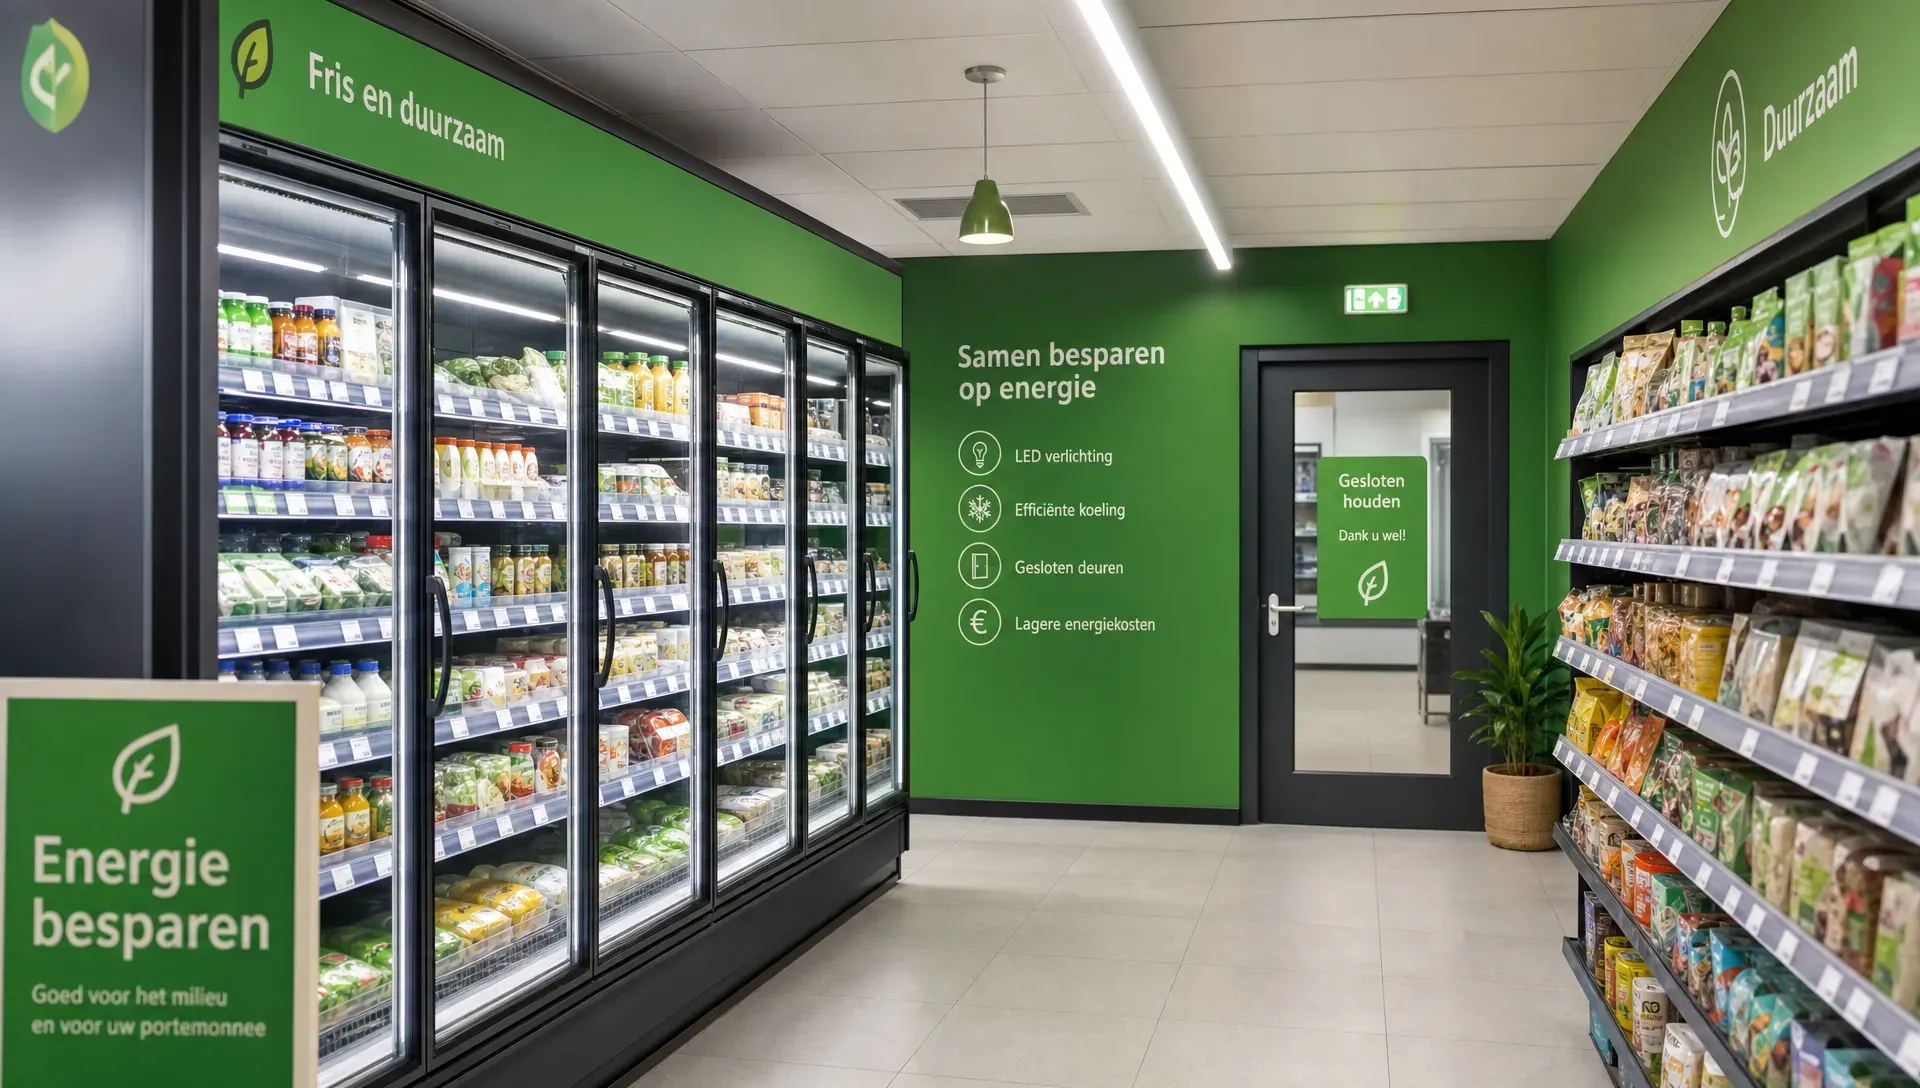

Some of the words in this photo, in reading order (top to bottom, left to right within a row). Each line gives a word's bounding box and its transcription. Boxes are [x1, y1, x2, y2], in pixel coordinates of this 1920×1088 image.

[309, 51, 355, 104] Fris
[363, 84, 392, 118] en
[400, 91, 505, 161] duurzaam
[1763, 46, 1858, 162] Duurzaam
[958, 344, 1041, 369] Samen
[1049, 341, 1165, 372] besparen
[959, 381, 991, 406] op
[999, 374, 1096, 405] energie
[1015, 449, 1041, 463] LED
[1045, 449, 1113, 467] verlichting
[1338, 473, 1405, 488] Gesloten
[1015, 502, 1075, 517] Efficiënte
[1079, 502, 1126, 520] koeling
[1343, 493, 1401, 509] houden
[1338, 529, 1369, 542] Dank
[1371, 532, 1379, 542] u
[1382, 528, 1406, 542] wel!
[1015, 559, 1074, 575] Gesloten
[1078, 560, 1124, 575] deuren
[1015, 616, 1061, 635] Lagere
[1065, 616, 1156, 635] energiekosten
[33, 834, 230, 899] Energie
[32, 896, 270, 962] besparen
[31, 983, 84, 1005] Goed
[88, 989, 131, 1006] voor
[135, 985, 167, 1006] het
[171, 986, 228, 1007] milieu
[31, 1018, 55, 1035] en
[59, 1019, 103, 1035] voor
[106, 1020, 136, 1036] uw
[139, 1018, 267, 1041] portemonnee
